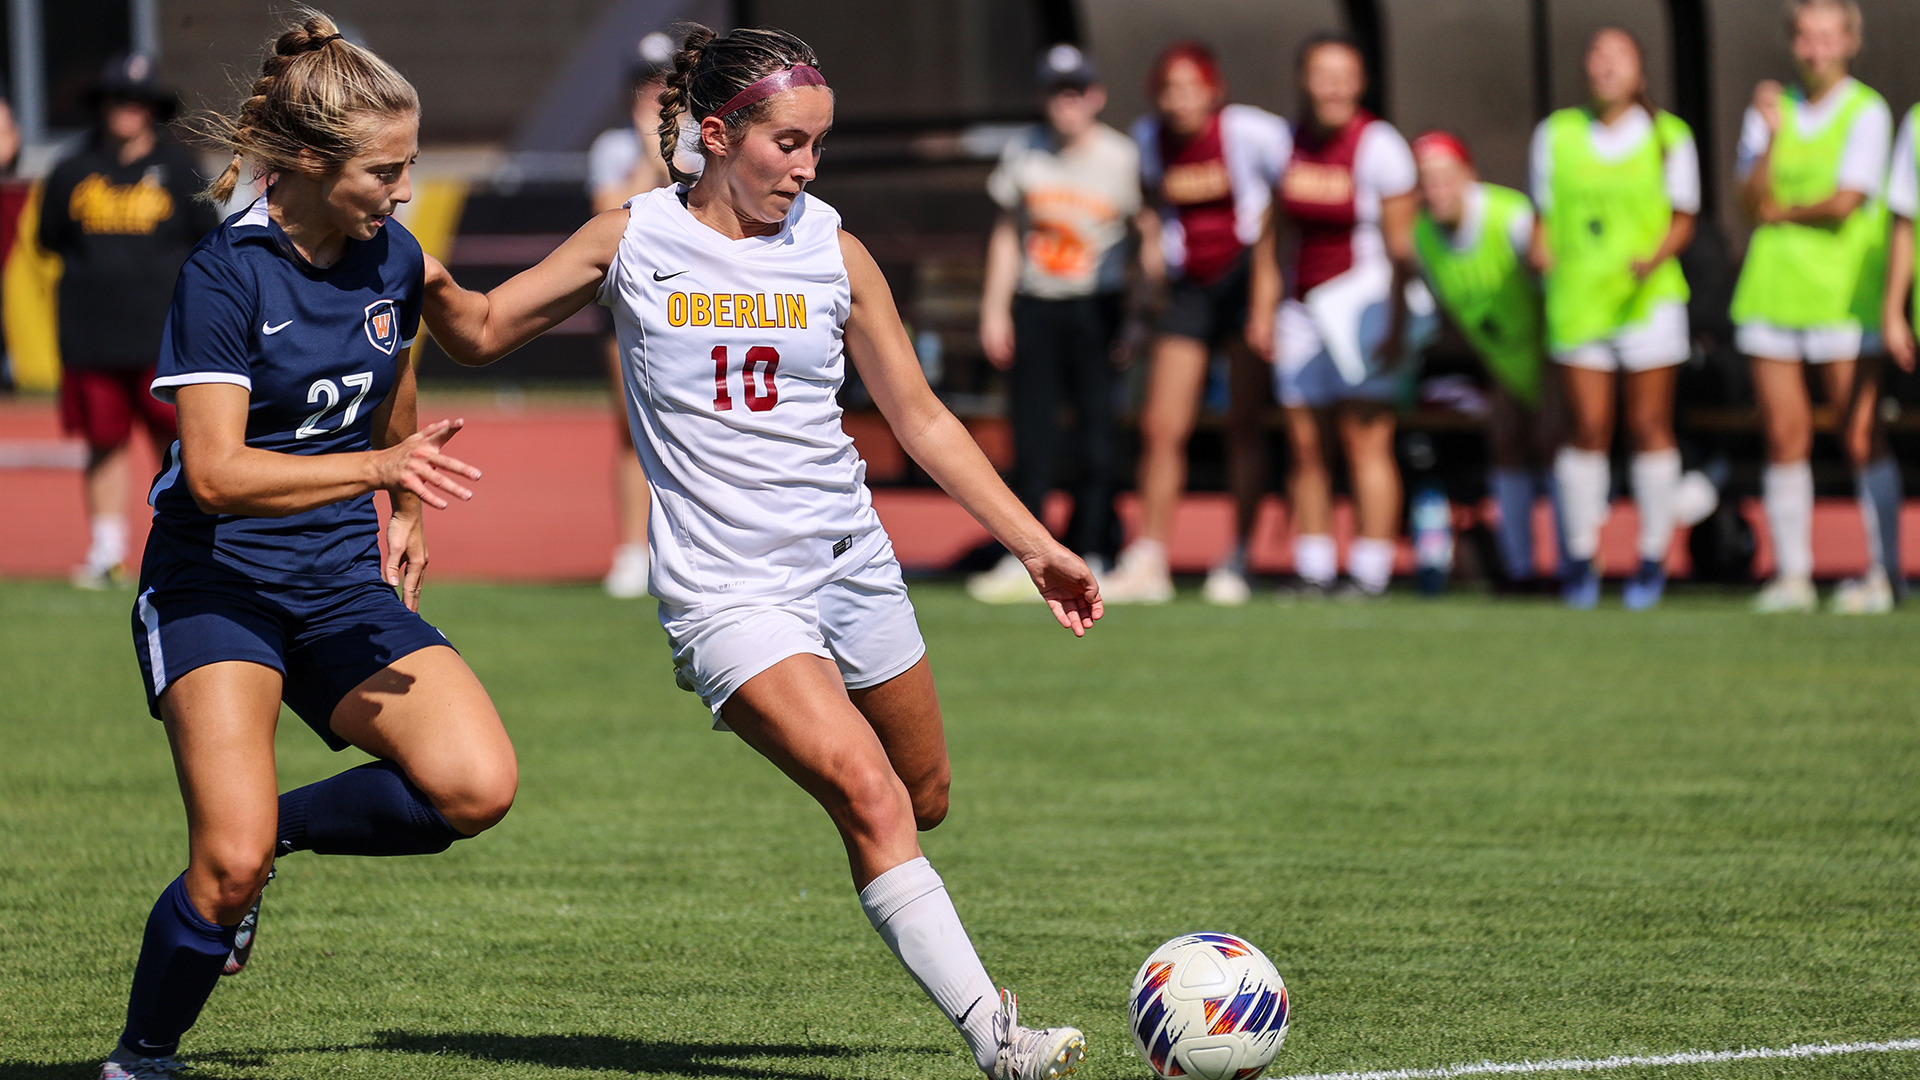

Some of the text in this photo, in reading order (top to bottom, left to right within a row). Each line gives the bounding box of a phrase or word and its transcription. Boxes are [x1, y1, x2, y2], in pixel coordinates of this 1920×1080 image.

[373, 313, 390, 339] W
[667, 292, 808, 329] OBERLIN
[711, 345, 780, 412] 10
[296, 371, 373, 439] 27
